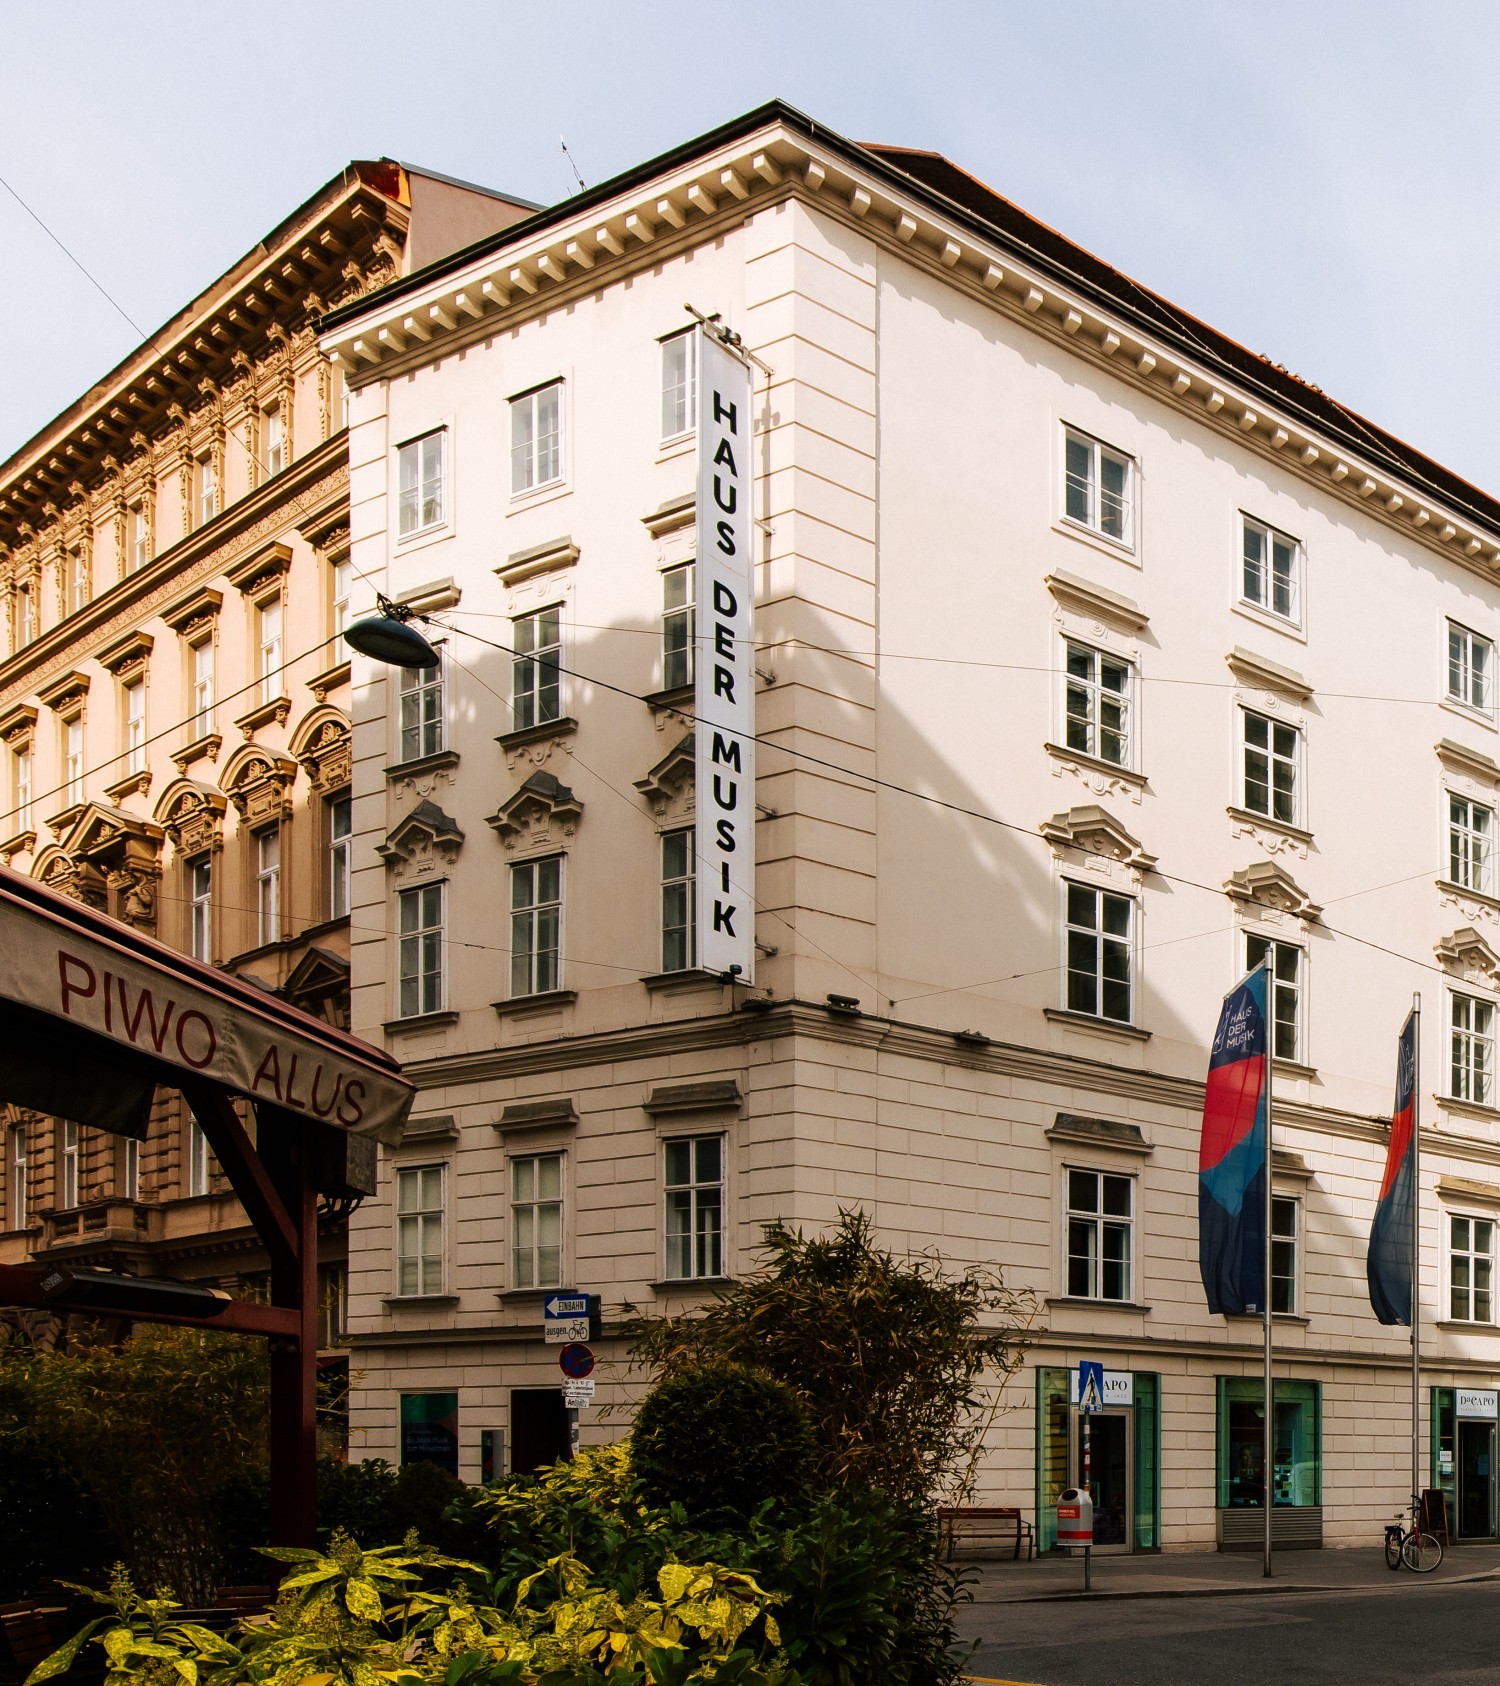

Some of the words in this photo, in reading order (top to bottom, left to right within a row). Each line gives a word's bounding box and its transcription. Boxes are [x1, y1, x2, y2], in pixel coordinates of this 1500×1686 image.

[712, 389, 738, 556] HAUS
[712, 579, 738, 705] DER
[712, 731, 742, 940] MUSIK
[1230, 1006, 1252, 1024] HAUS
[58, 950, 217, 1069] PIWO
[251, 1044, 366, 1127] ALUS
[1228, 1021, 1247, 1036] DER
[1226, 1029, 1255, 1049] MUSIK
[558, 1301, 585, 1312] EINBAHN
[546, 1327, 569, 1338] ausgen.
